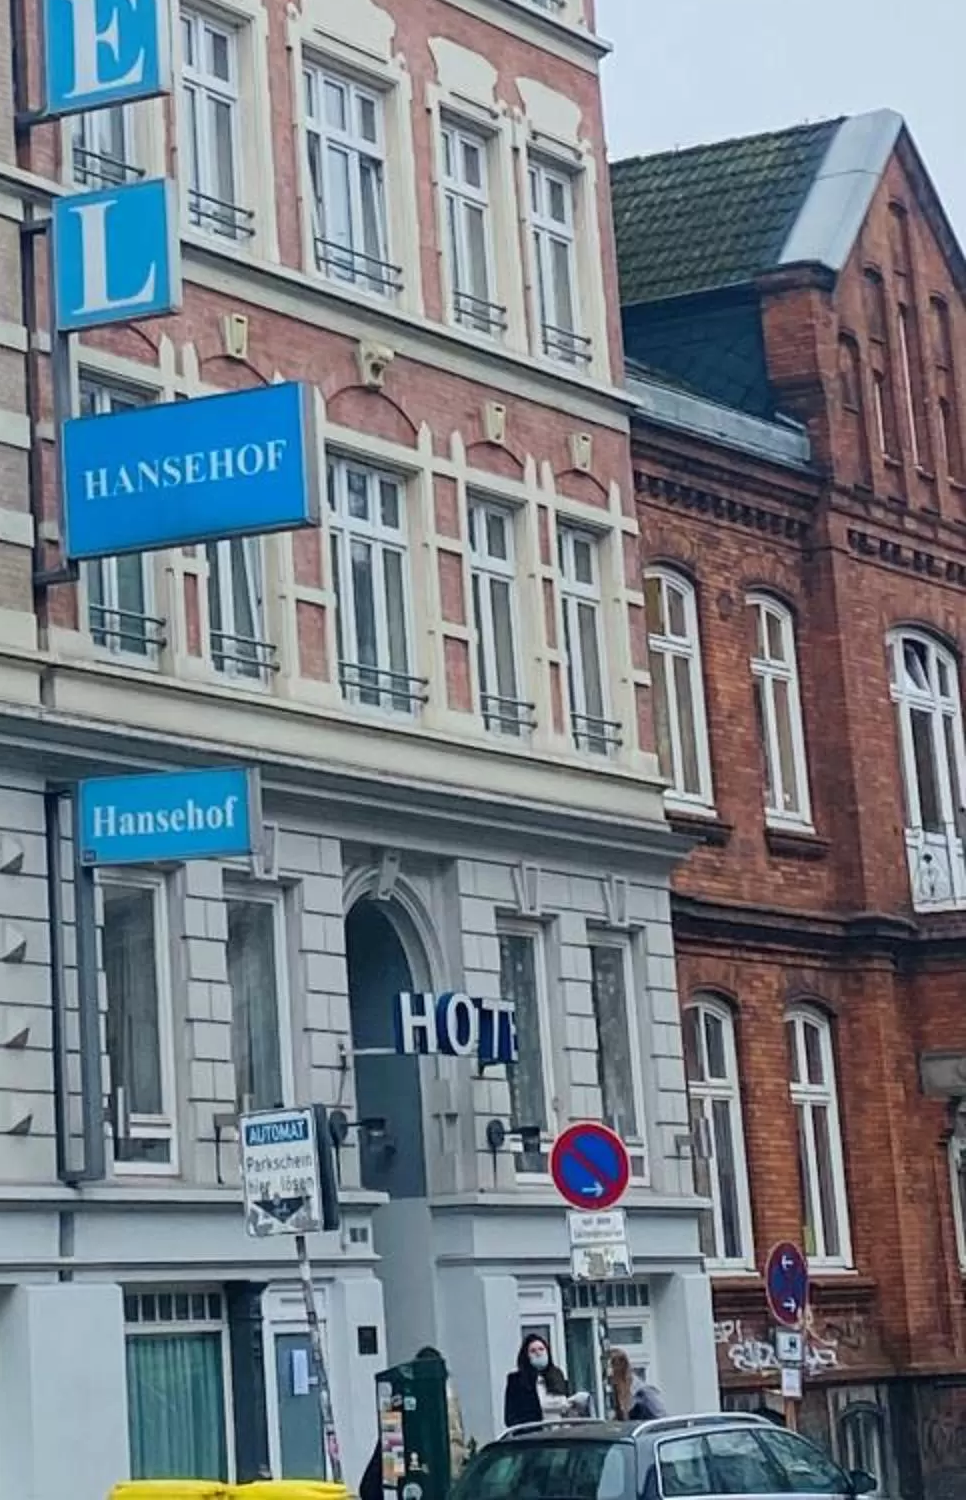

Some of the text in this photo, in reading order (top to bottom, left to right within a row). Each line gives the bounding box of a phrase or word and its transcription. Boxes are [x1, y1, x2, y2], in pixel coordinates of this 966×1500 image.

[85, 439, 287, 500] HANSEHOF
[93, 795, 239, 838] Hansehof
[249, 1121, 305, 1143] AUTOMAT
[246, 1155, 313, 1172] Parkschein
